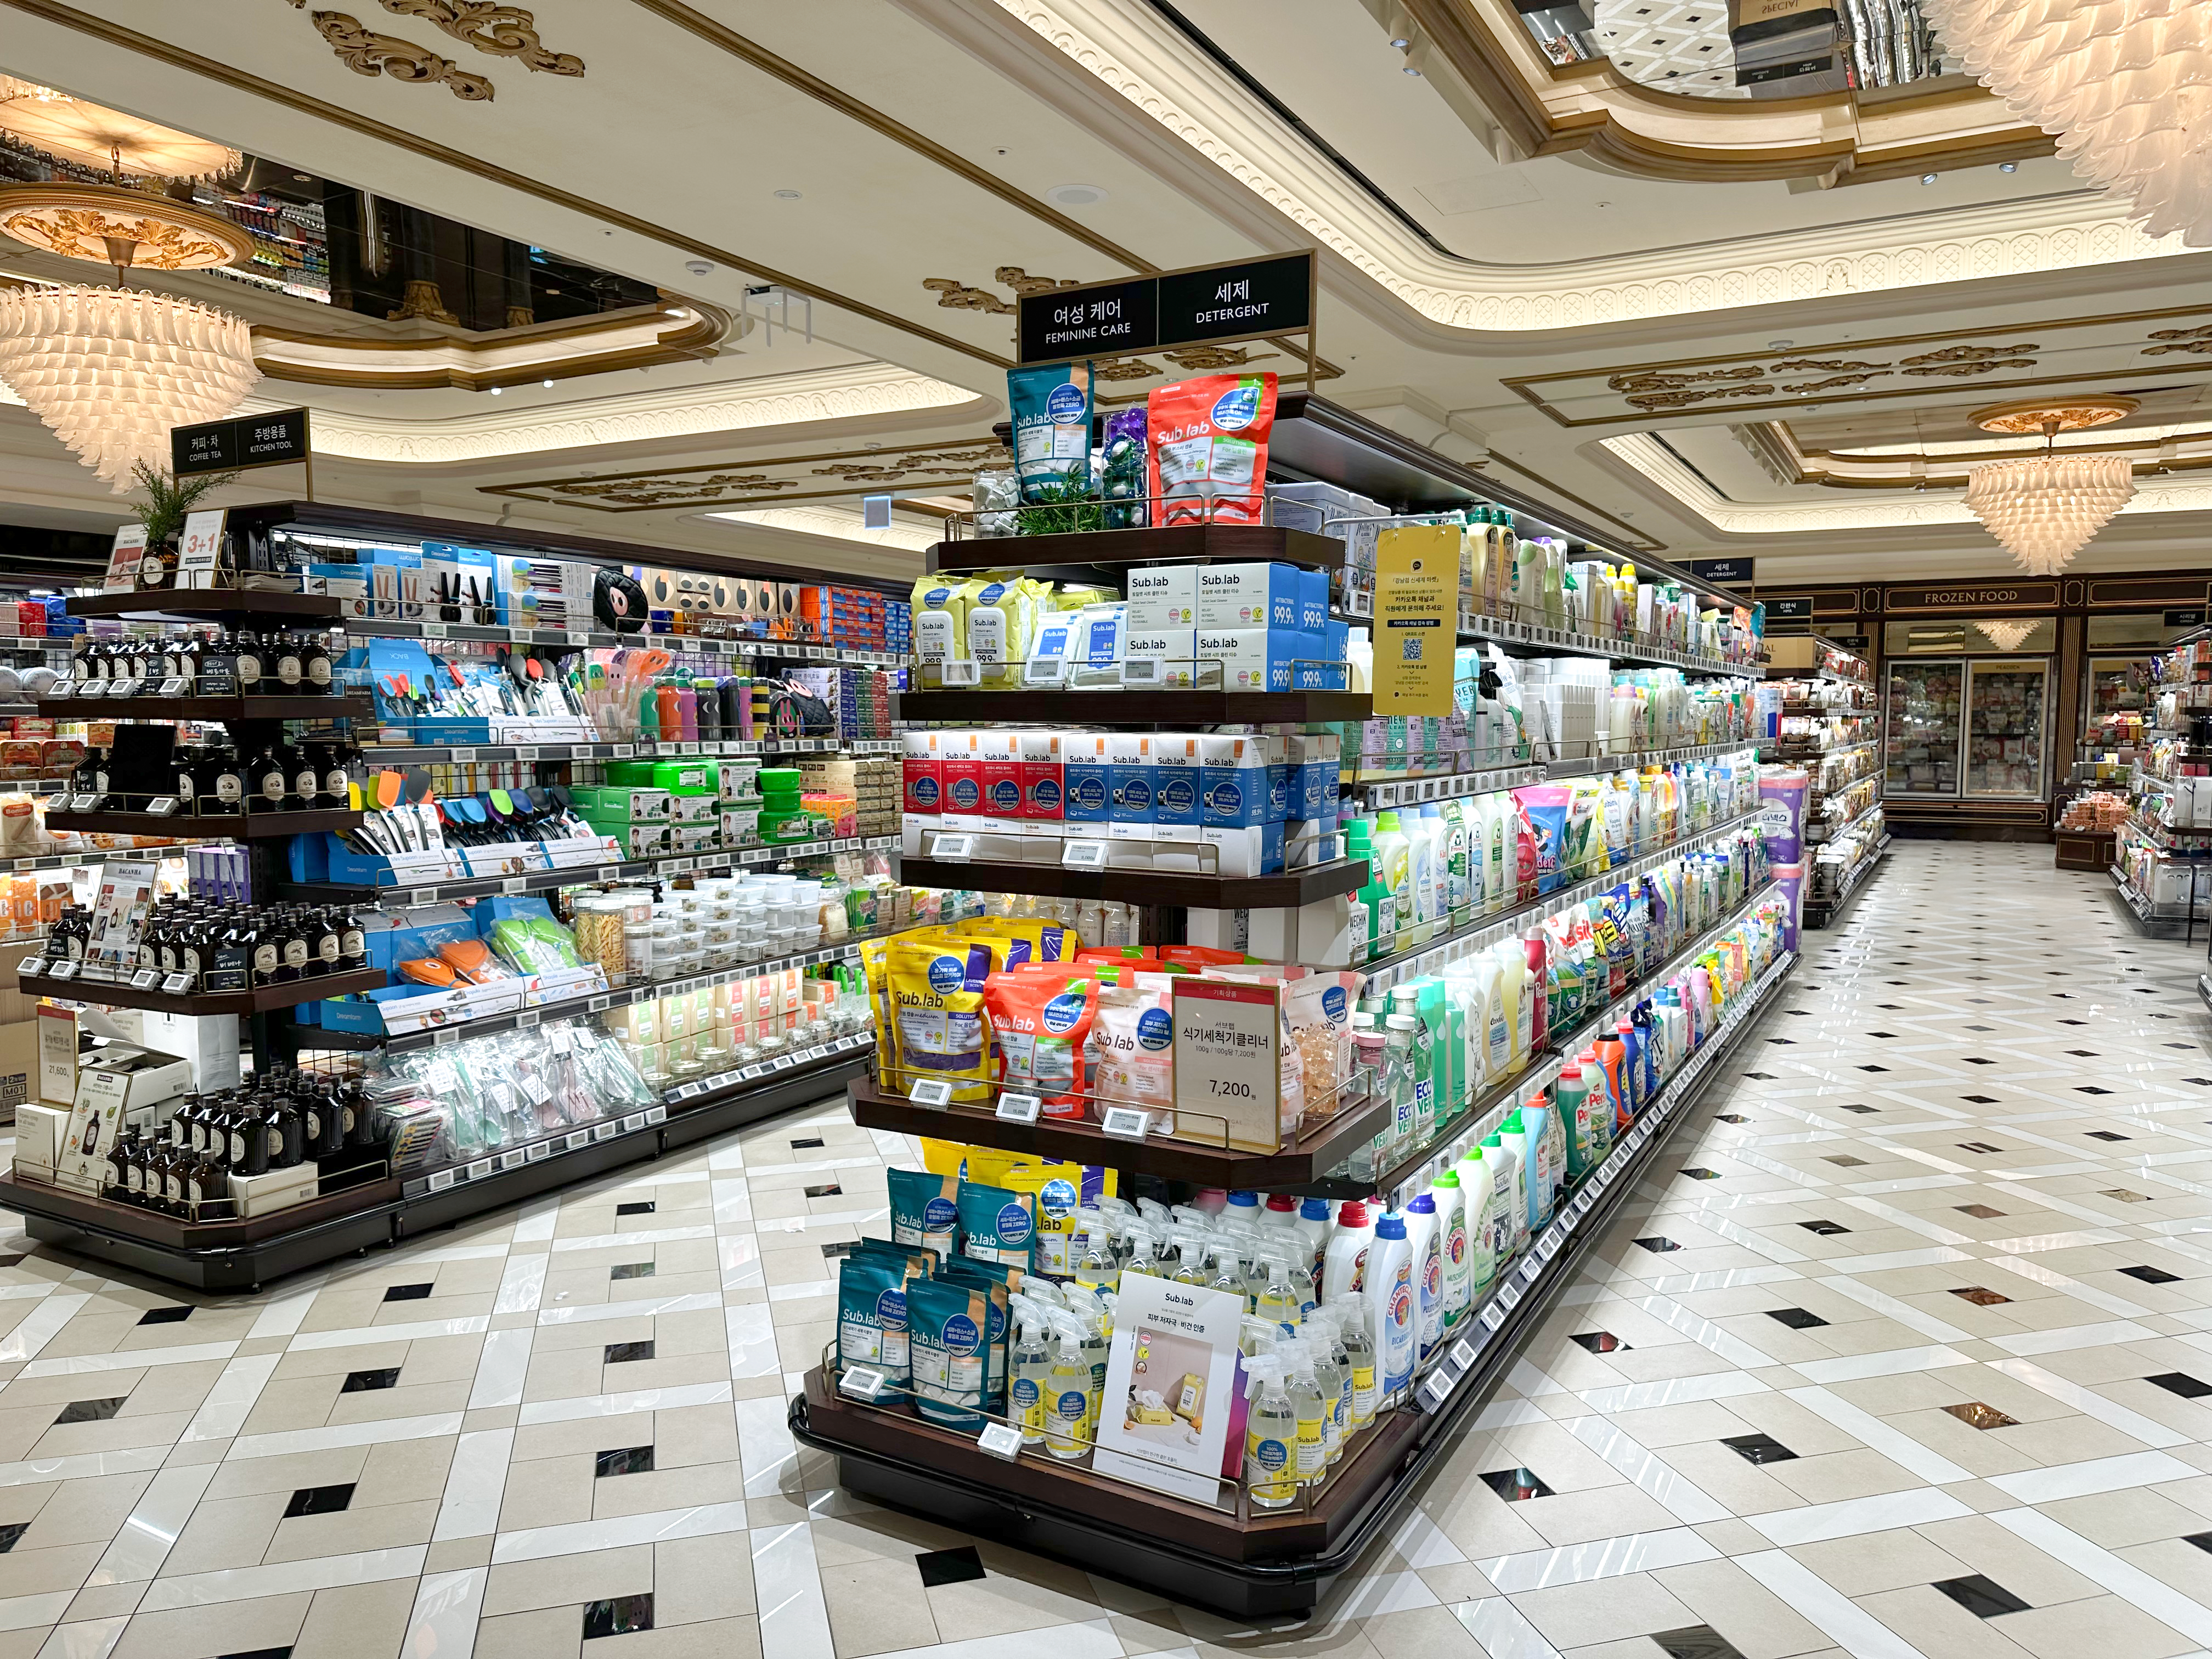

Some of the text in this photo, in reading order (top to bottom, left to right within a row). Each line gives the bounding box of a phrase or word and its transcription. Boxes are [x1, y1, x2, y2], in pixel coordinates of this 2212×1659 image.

[1215, 279, 1249, 302] 세제
[1054, 298, 1121, 325] 여성 케어
[1196, 303, 1269, 324] DETERGENT
[1045, 323, 1131, 343] FEMININE CARE
[1017, 411, 1051, 429] Sub.lab
[254, 424, 286, 441] 주방용품
[1157, 421, 1210, 444] Sub.lab
[250, 440, 292, 454] KITCHEN TOOL
[1223, 438, 1247, 447] SOLUTION
[187, 533, 216, 554] 3+1
[1714, 563, 1729, 571] 세제
[1132, 577, 1169, 588] Sub.lab
[1201, 574, 1240, 585] Sub.lab
[1925, 590, 2018, 603] FROZEN FOOD
[1273, 605, 1294, 624] 99.9%
[1303, 610, 1324, 628] 99.9%
[1130, 639, 1166, 650] Sub.lab
[1200, 637, 1238, 648] Sub.lab
[1302, 670, 1323, 687] 99.9%
[906, 751, 929, 759] Sub.lab
[946, 752, 970, 760] Sub.lab
[984, 753, 1009, 761] Sub.lab
[1025, 754, 1051, 763] Sub.lab
[1069, 755, 1096, 764] Sub.lab
[1113, 756, 1141, 764] Sub.lab
[1158, 757, 1186, 766] Sub.lab
[1204, 758, 1234, 767] Sub.lab
[5, 806, 32, 815] Bonomi
[1350, 913, 1367, 928] WECHIK
[896, 991, 943, 1008] Sub.lab
[1213, 989, 1237, 999] 기획상품
[336, 1012, 362, 1020] Dreamfarm
[994, 1014, 1035, 1031] Sub.lab
[1215, 1021, 1235, 1030] 서브랩
[1097, 1032, 1134, 1051] Sub.lab
[1183, 1026, 1268, 1049] 식기세척기클리너
[1195, 1045, 1209, 1054] 100g
[1214, 1047, 1234, 1057] 100g당
[1234, 1049, 1256, 1059] 7,200원
[49, 1065, 67, 1076] 21,600
[5, 1086, 24, 1096] M01
[1209, 1079, 1251, 1098] 7,200
[1415, 1083, 1432, 1099] ECO
[1398, 1105, 1413, 1121] ECO
[895, 1210, 922, 1229] Sub.lab
[1165, 1293, 1194, 1306] Sub.lab
[842, 1308, 881, 1327] Sub.lab
[1147, 1313, 1205, 1333] 피부 저자극 비건 인증
[911, 1329, 945, 1350] Sub.lab
